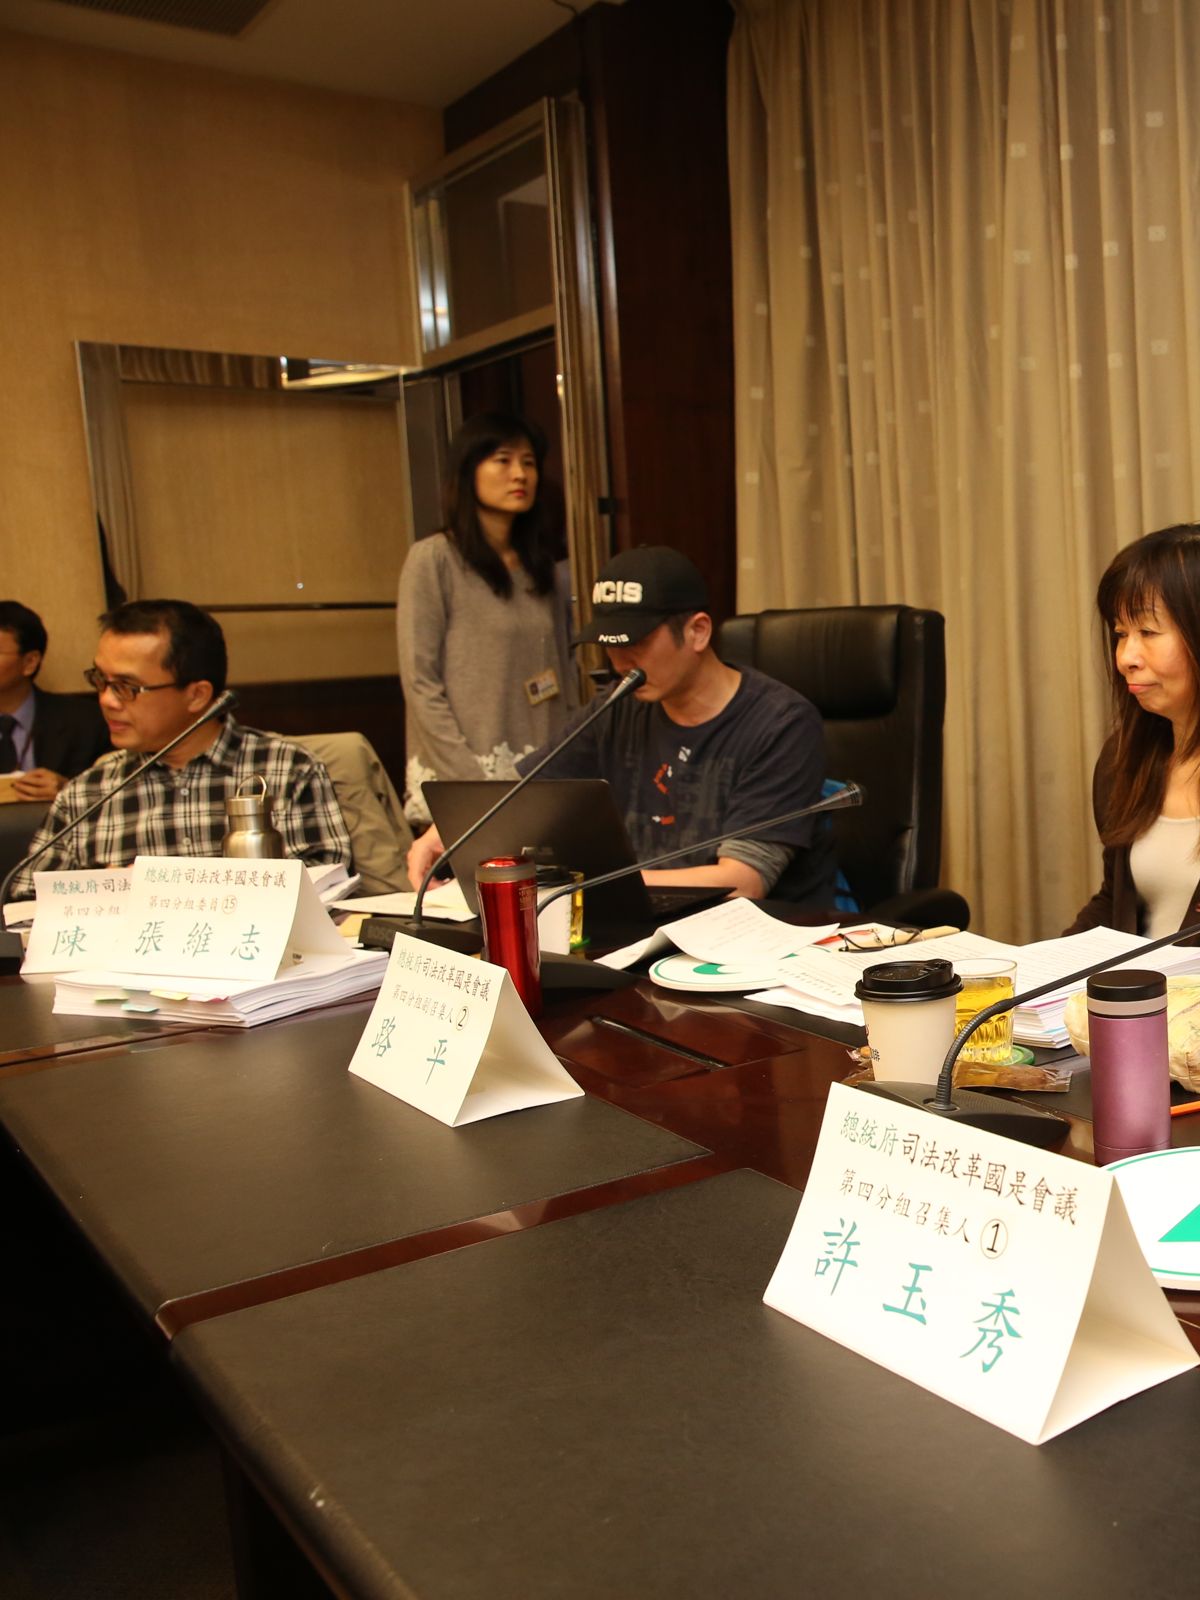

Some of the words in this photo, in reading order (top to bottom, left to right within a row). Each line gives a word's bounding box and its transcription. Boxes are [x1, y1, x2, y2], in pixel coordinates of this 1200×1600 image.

[598, 633, 630, 644] NCIS
[144, 867, 287, 888] 總統府司法改革國是會議
[52, 925, 87, 957] 陳
[398, 948, 492, 1001] 總統府司法改革國是會議
[839, 1110, 1079, 1225] 總統府司法改革國是會議
